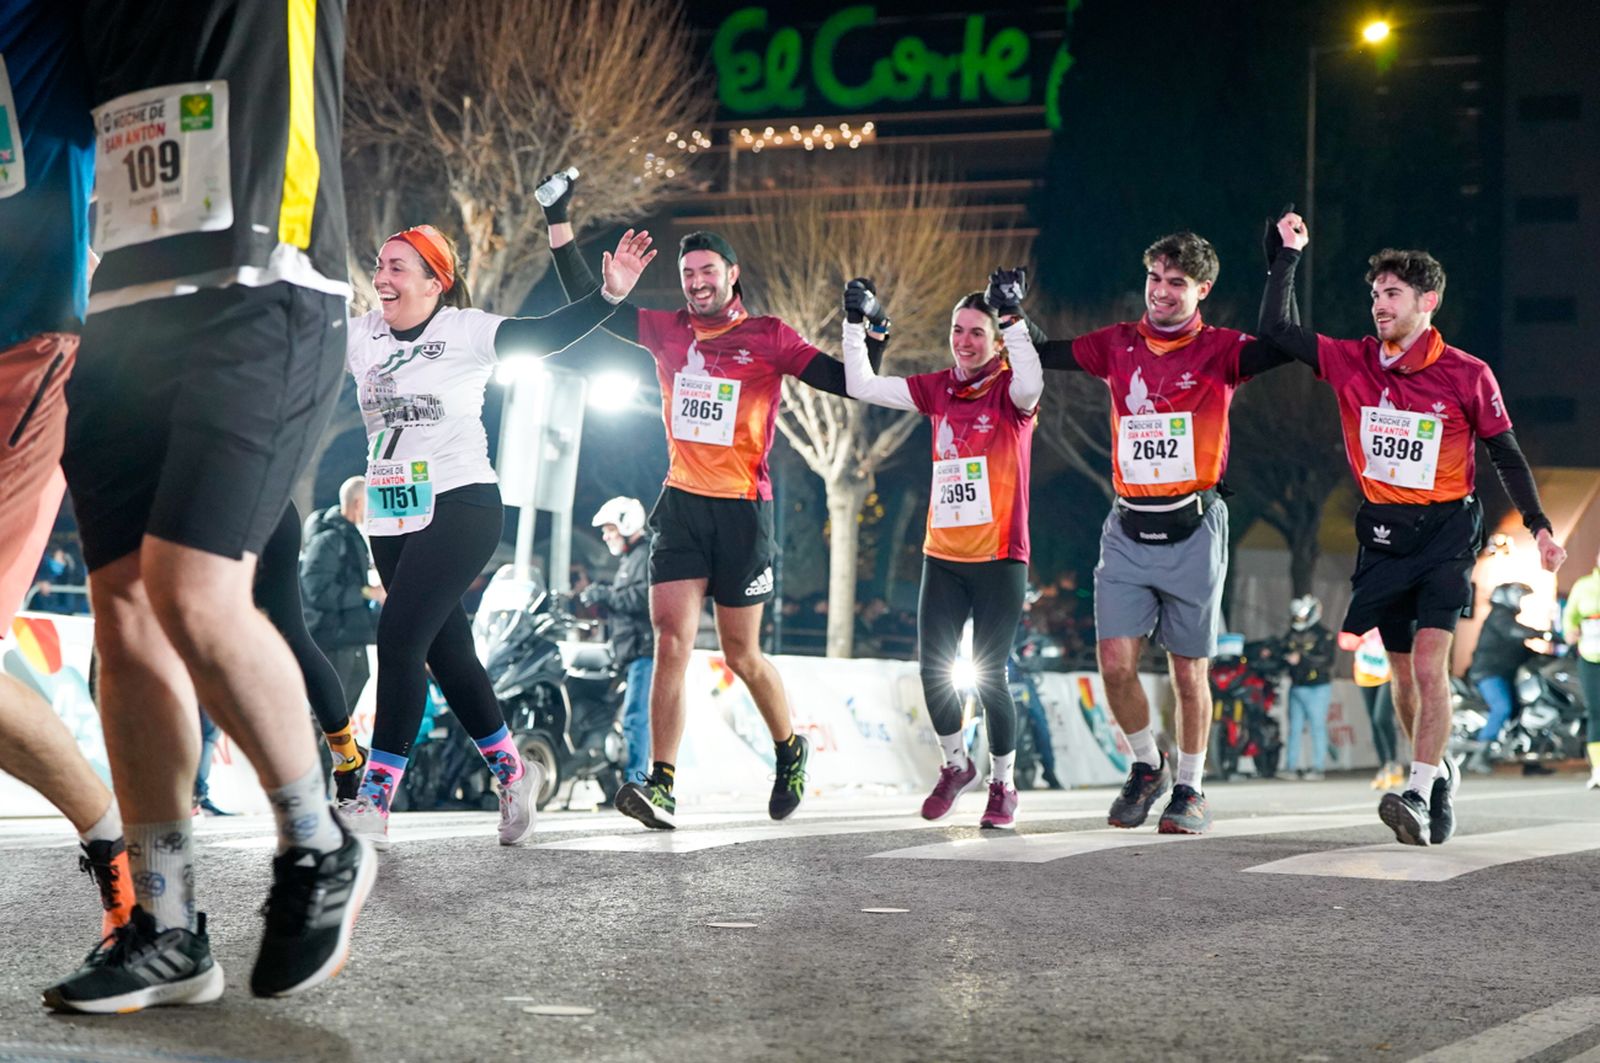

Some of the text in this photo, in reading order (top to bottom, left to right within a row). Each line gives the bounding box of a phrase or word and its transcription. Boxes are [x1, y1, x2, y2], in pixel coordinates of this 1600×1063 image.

[713, 7, 805, 112] El
[811, 5, 1031, 106] Corte
[113, 108, 147, 128] NOCHE
[149, 105, 165, 120] DE
[105, 134, 123, 154] SAN
[122, 139, 181, 193] 109
[681, 398, 724, 421] 2865
[1134, 422, 1153, 430] NOCHE
[1368, 423, 1383, 433] SAN
[1378, 417, 1411, 428] NOCHE DE
[1133, 439, 1178, 460] 2642
[1372, 435, 1424, 462] 5398
[378, 485, 418, 509] 7751
[940, 482, 976, 504] 2595
